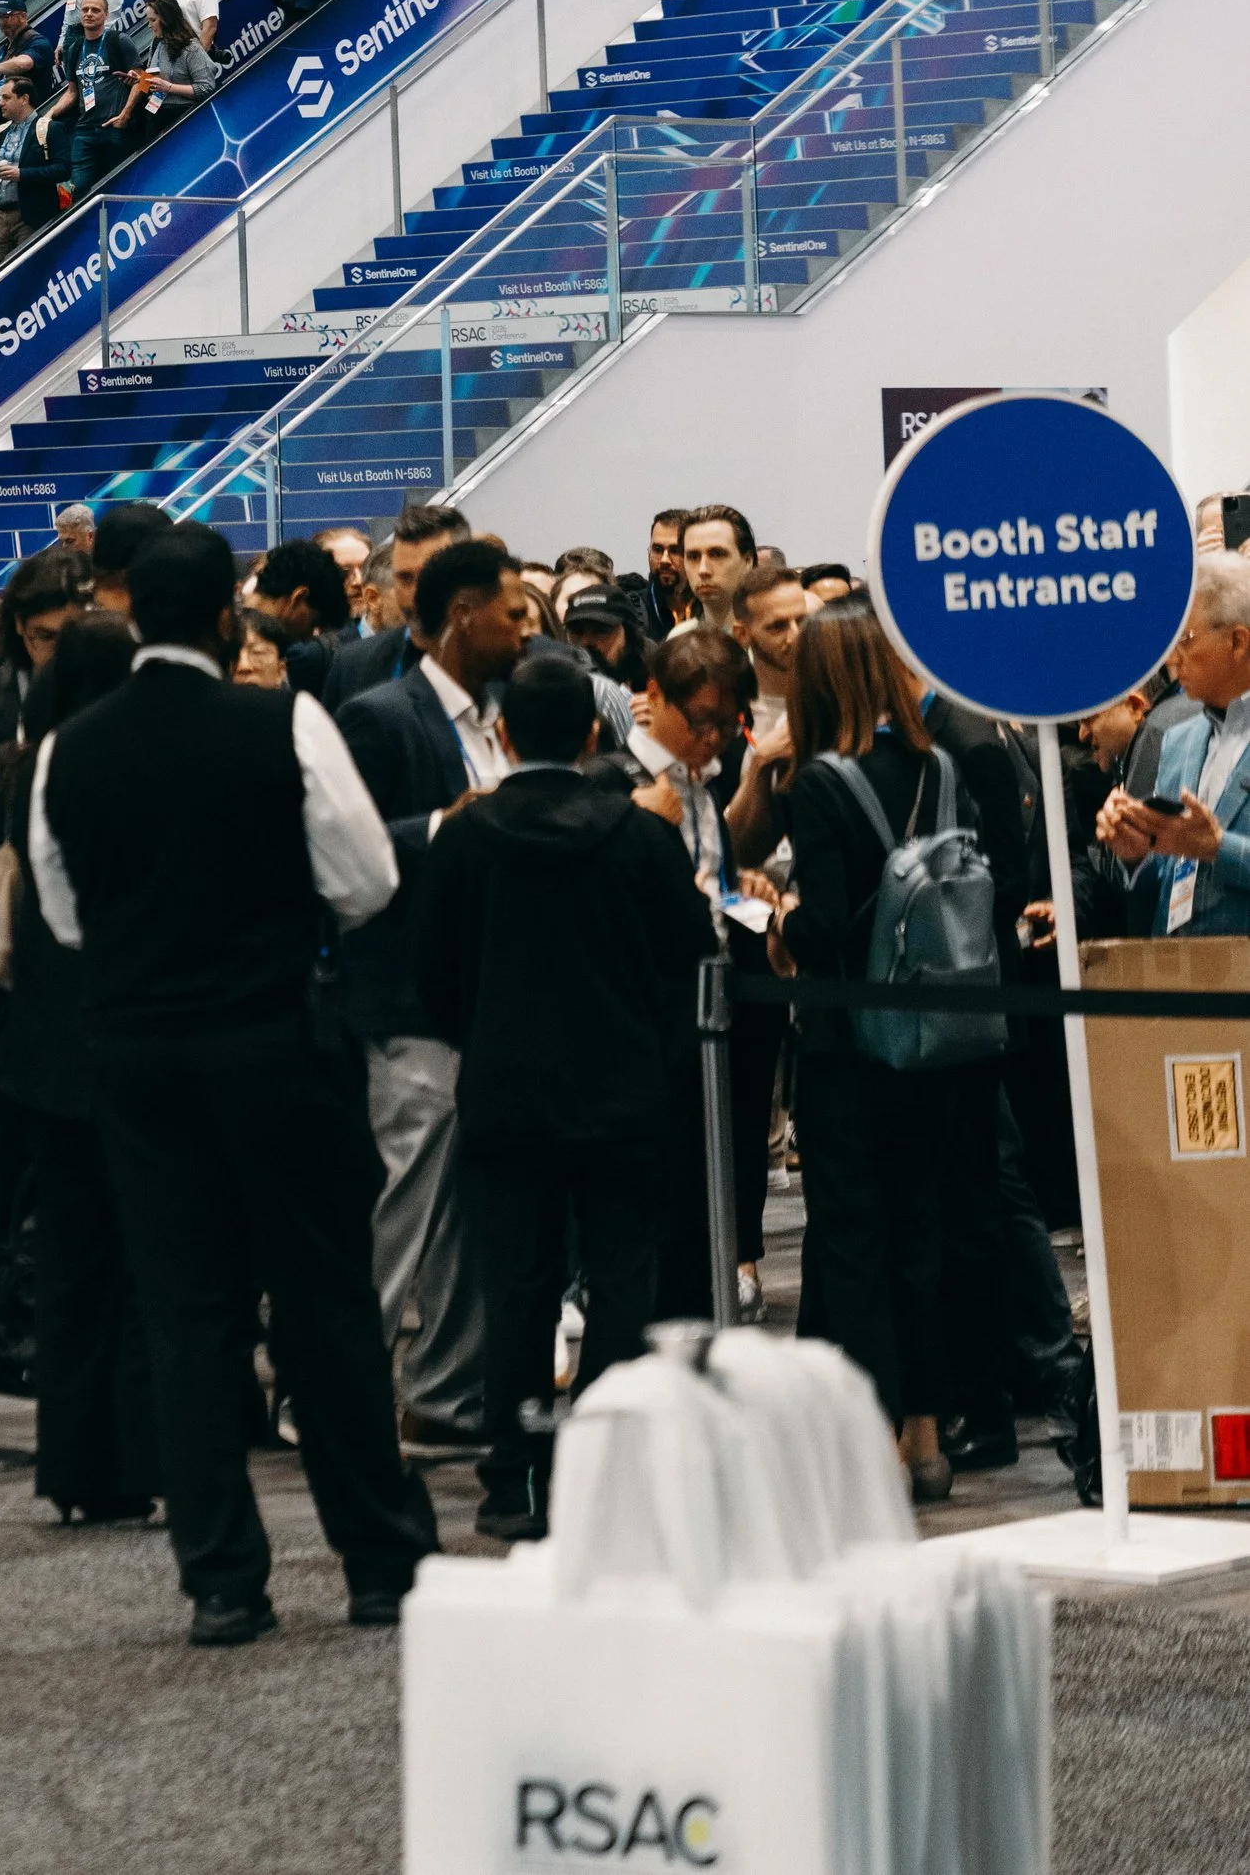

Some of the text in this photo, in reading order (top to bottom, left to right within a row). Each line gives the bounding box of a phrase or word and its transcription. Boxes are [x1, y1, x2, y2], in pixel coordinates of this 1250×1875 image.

[600, 70, 651, 84] SentinelOne
[832, 141, 853, 152] Visit
[854, 139, 867, 150] Us
[909, 133, 946, 146] N-5863
[470, 170, 489, 180] Visit
[490, 169, 502, 179] Us
[503, 168, 511, 178] at
[514, 165, 539, 176] Booth
[769, 239, 827, 253] SentinelOne
[365, 267, 417, 280] SentinelOne
[499, 278, 607, 295] Visit Us at Booth N-5863
[623, 298, 658, 313] RSAC
[451, 327, 487, 343] RSAC
[184, 342, 217, 358] RSAC
[222, 348, 255, 357] Conference
[506, 351, 564, 364] SentinelOne
[264, 366, 283, 378] Visit
[285, 365, 297, 376] Us
[298, 365, 308, 375] at
[101, 375, 152, 387] SentinelOne
[901, 412, 938, 439] RS
[317, 467, 432, 483] Visit Us at Booth N-5863
[22, 483, 56, 495] N-5863
[914, 508, 1158, 562] Booth Staff
[943, 571, 1136, 612] Entrance
[514, 1777, 720, 1867] RSAC
